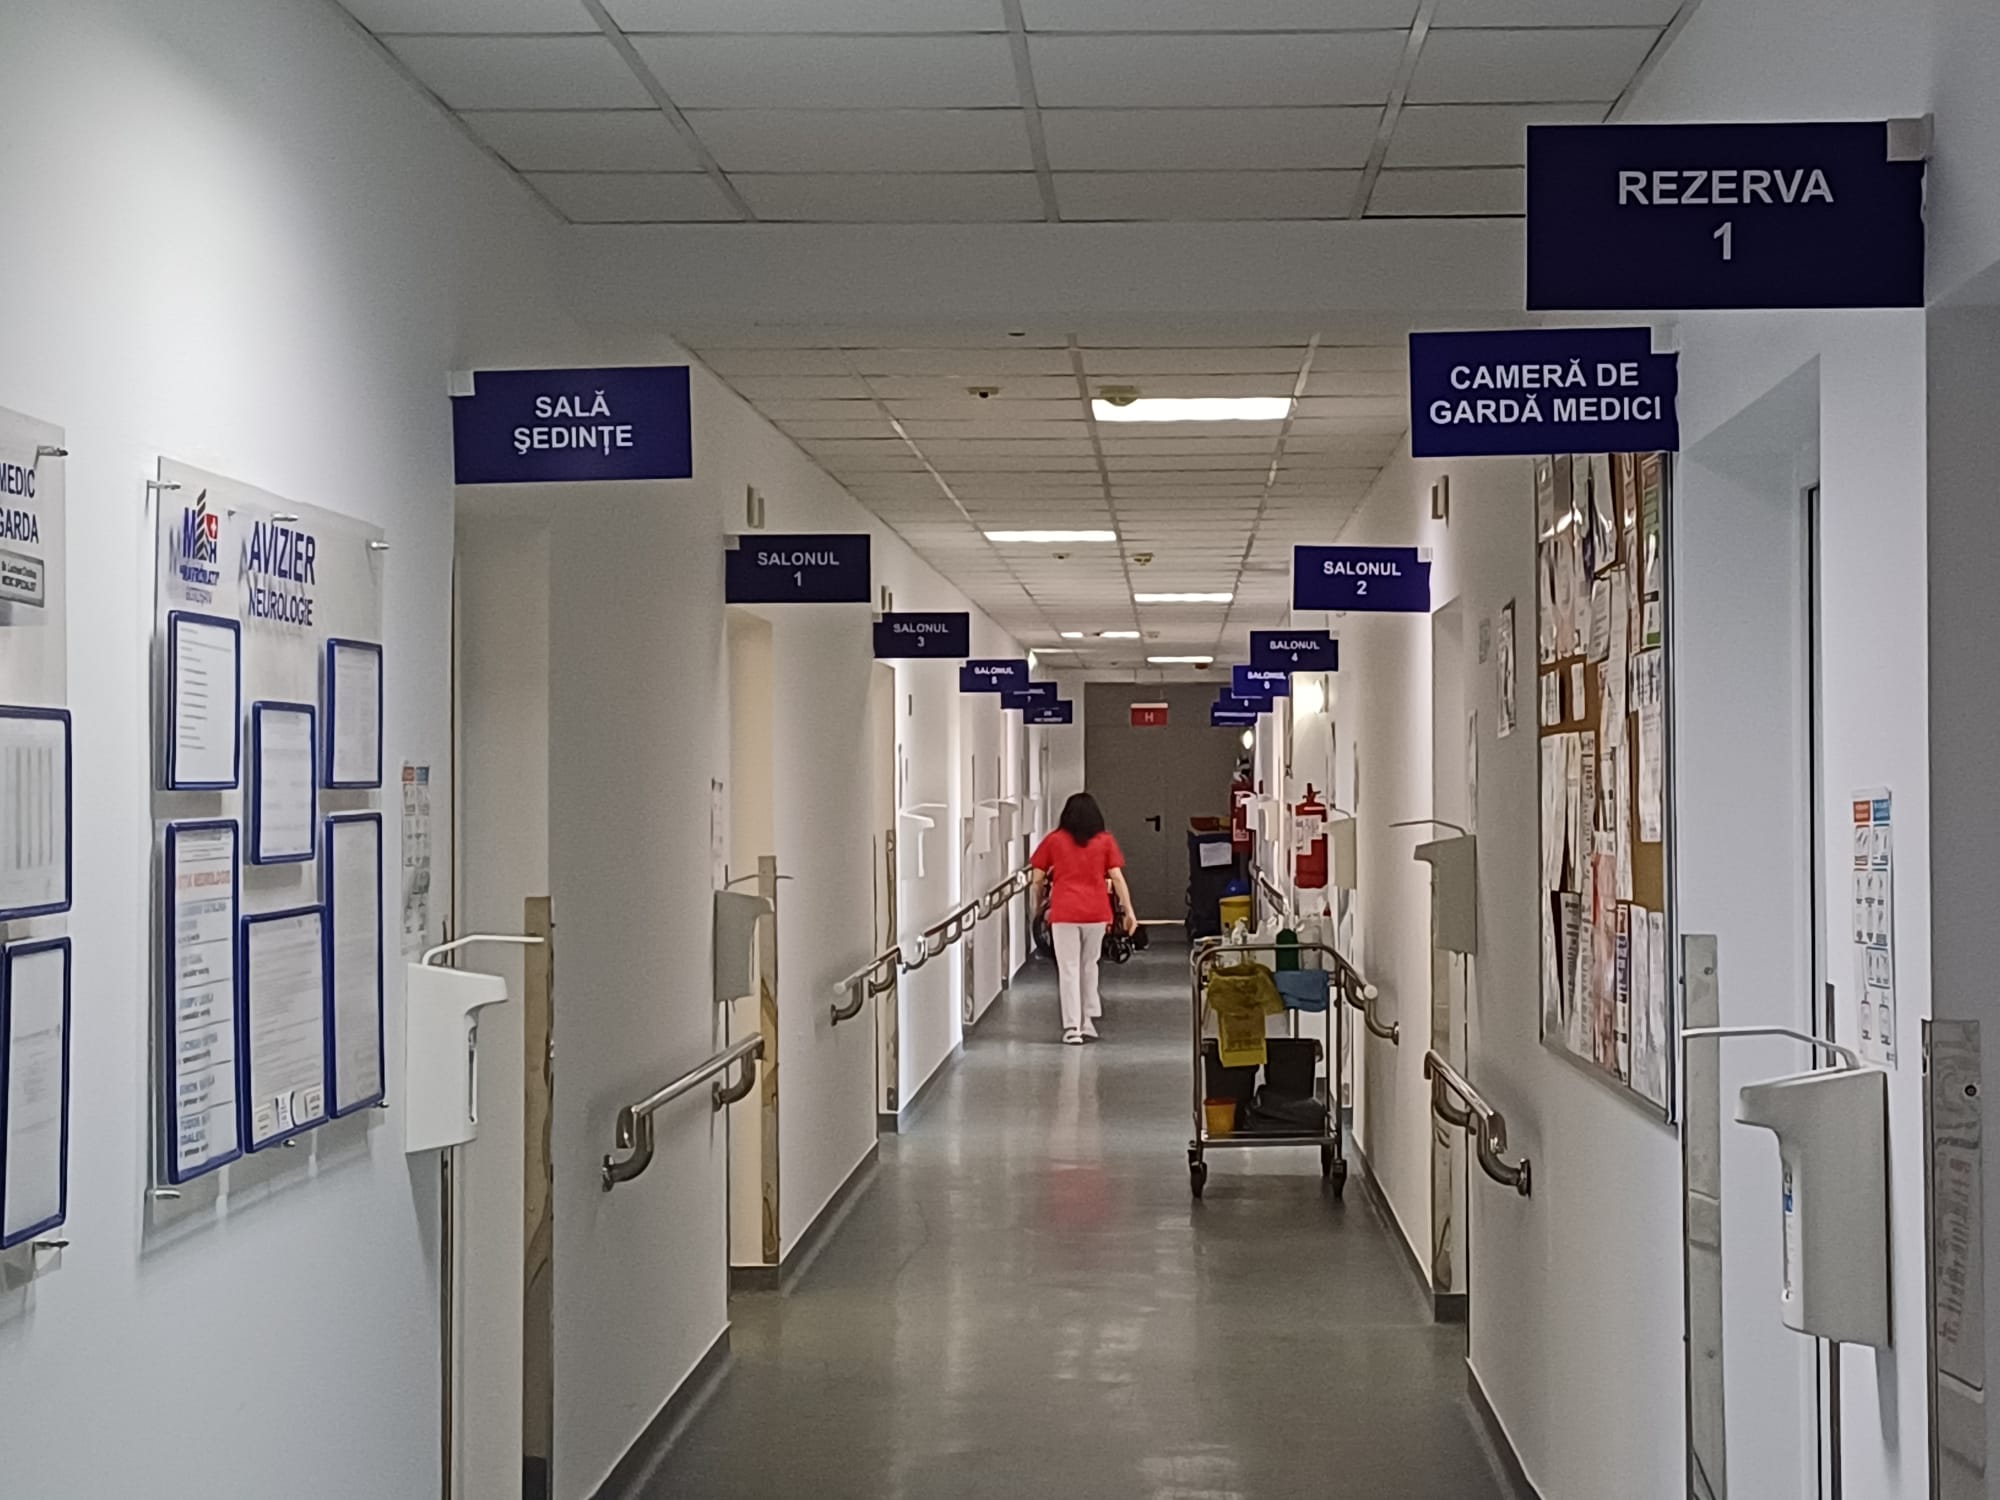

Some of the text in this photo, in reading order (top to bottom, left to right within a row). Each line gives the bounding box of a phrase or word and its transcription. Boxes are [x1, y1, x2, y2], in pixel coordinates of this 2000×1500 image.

[1618, 168, 1835, 205] REZERVA
[1713, 221, 1732, 260] 1
[1450, 358, 1639, 390] CAMERĂ DE
[535, 389, 611, 418] SALĂ
[1429, 393, 1662, 425] GARDĂ MEDICI
[248, 520, 316, 586] AVIZIER
[757, 552, 840, 566] SALONUL
[1323, 560, 1402, 576] SALONUL
[793, 571, 802, 586] 1
[1356, 580, 1367, 595] 2
[248, 588, 314, 626] NEUROLOGIE
[893, 623, 949, 633] SALONUL
[917, 636, 926, 647] 3
[1269, 640, 1320, 650] SALONUL
[1291, 652, 1298, 662] 4
[1144, 711, 1154, 723] H
